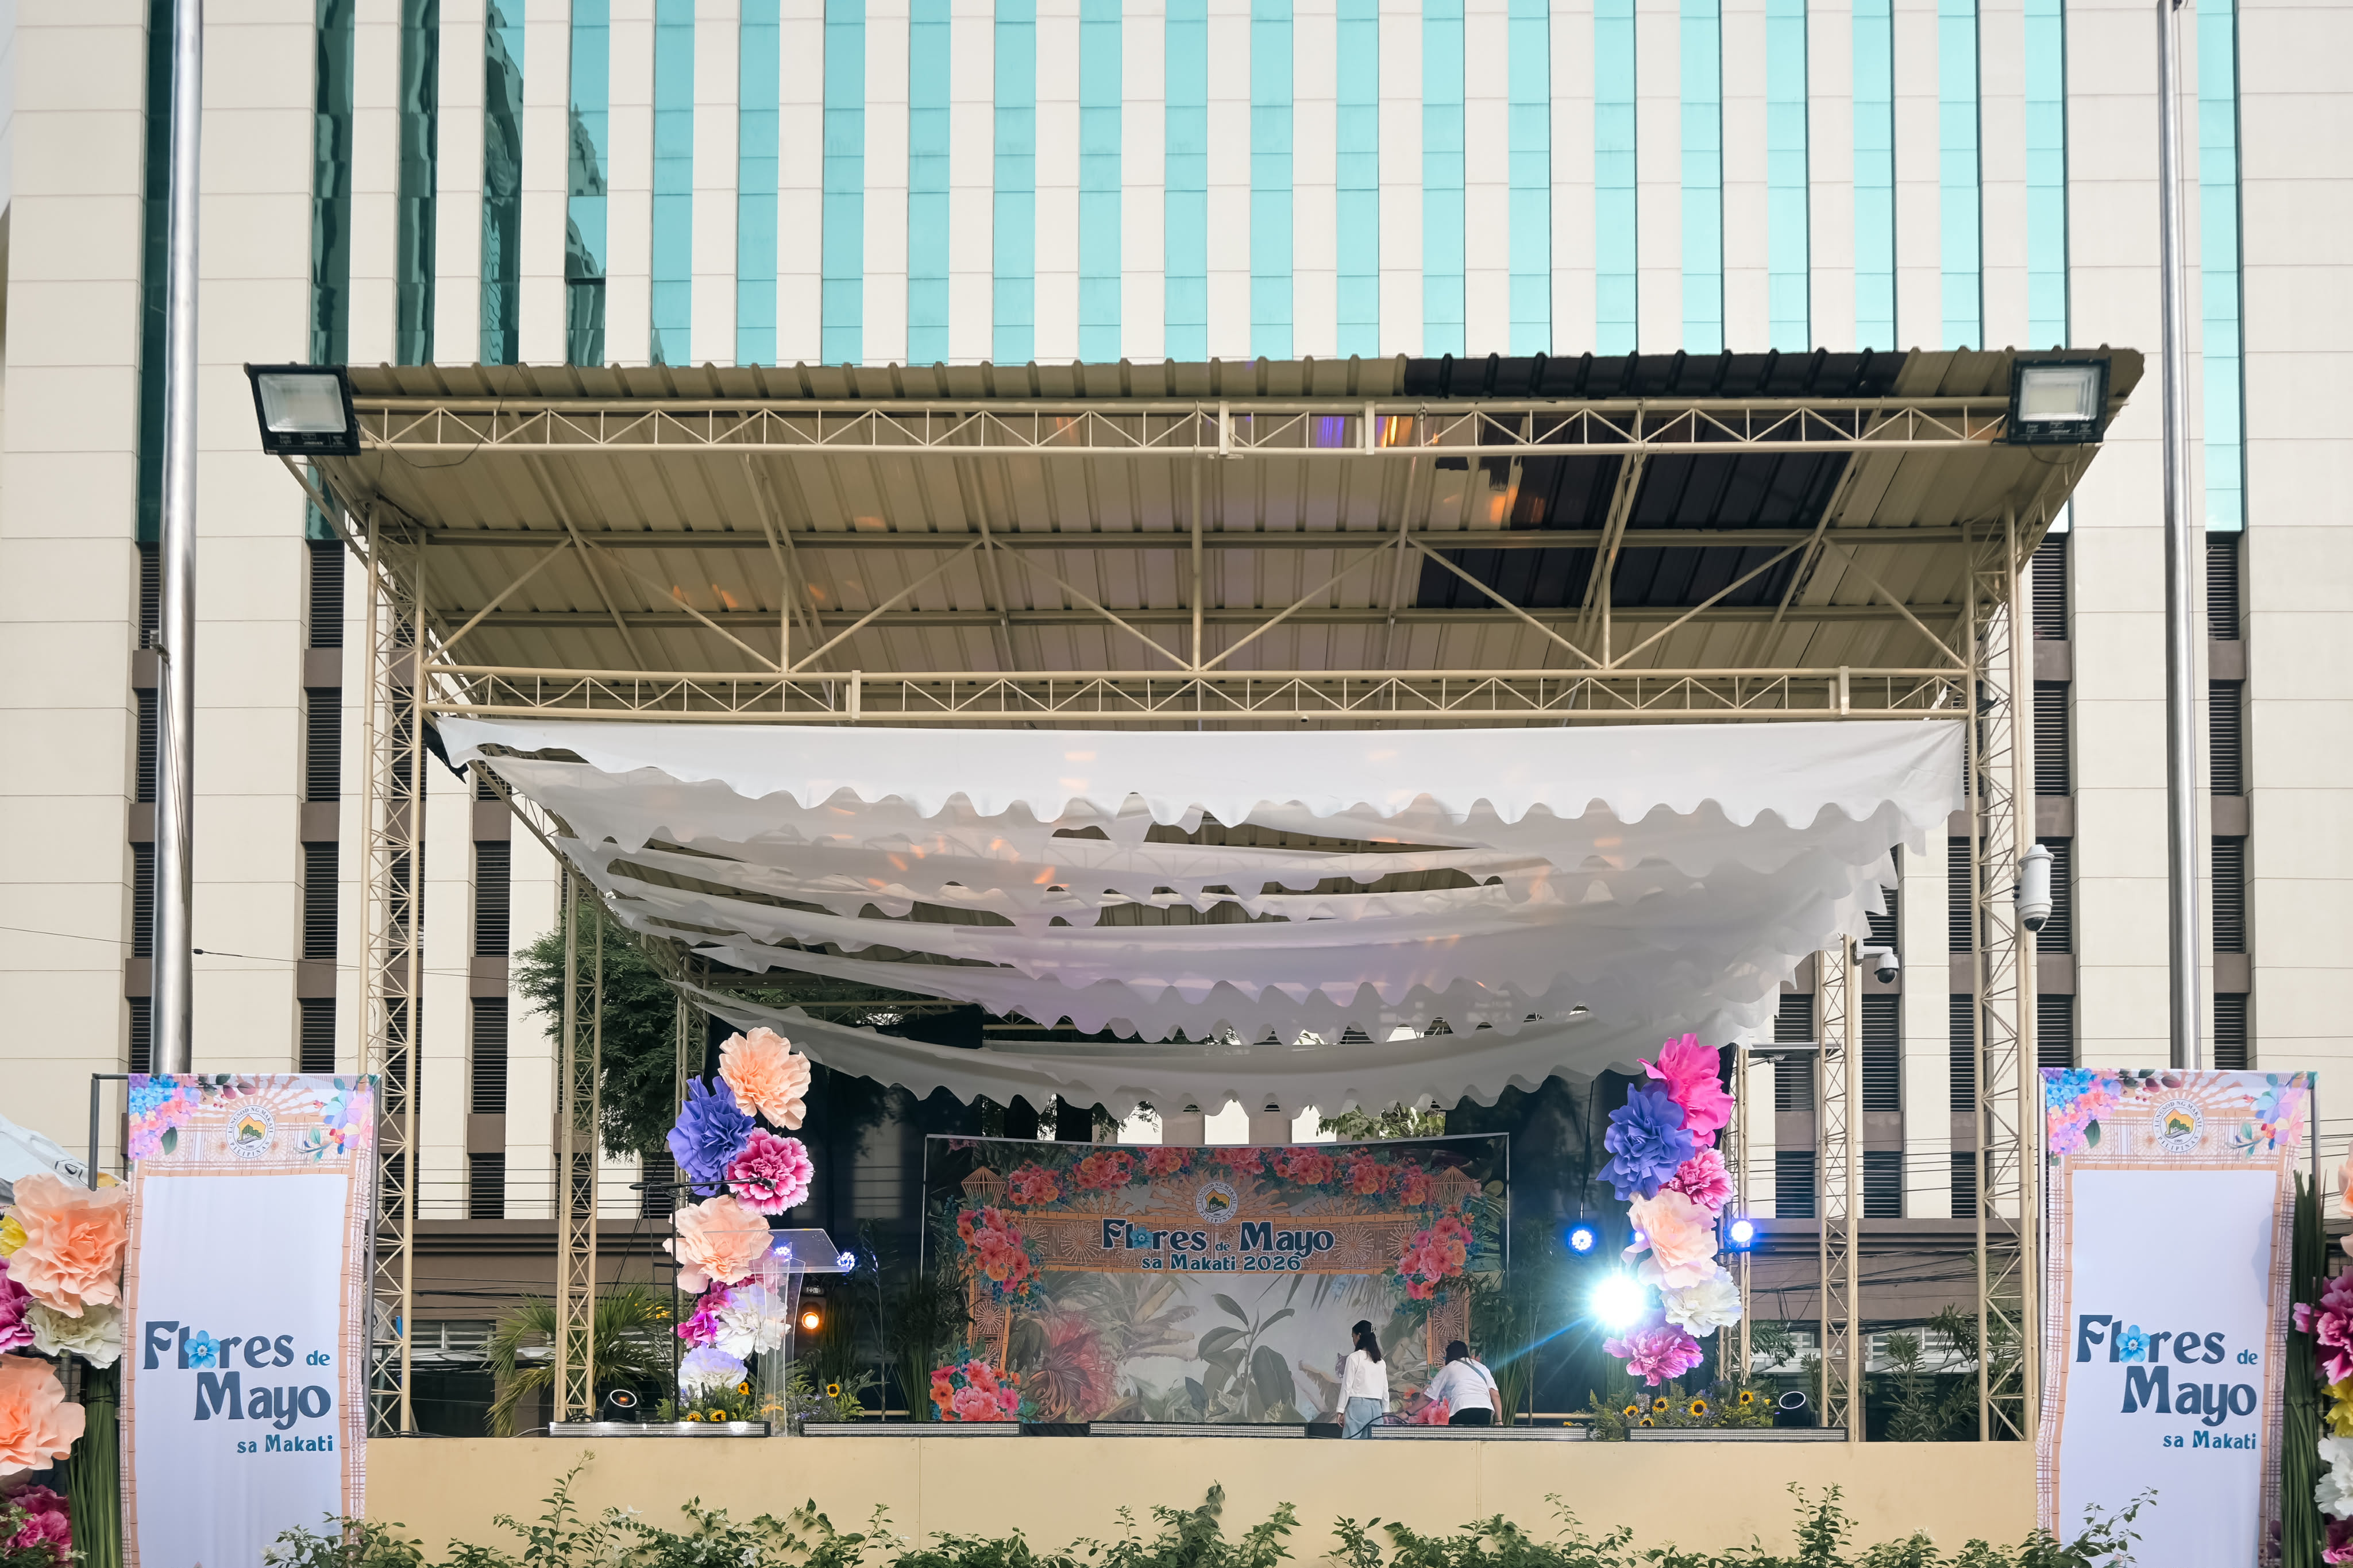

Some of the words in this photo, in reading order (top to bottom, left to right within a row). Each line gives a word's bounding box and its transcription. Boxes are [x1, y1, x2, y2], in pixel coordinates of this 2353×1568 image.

[228, 1107, 249, 1133] LUNGSOD
[261, 1110, 273, 1133] MAKATI
[2155, 1102, 2175, 1127] LUNGSOD
[2186, 1103, 2202, 1127] MAKATI
[230, 1142, 269, 1157] PILIPINAS
[2158, 1136, 2198, 1151] PILIPINAS
[1197, 1183, 1214, 1204] LUNGSOD
[1224, 1185, 1237, 1204] MAKATI
[1199, 1210, 1234, 1223] PILIPINAS
[1214, 1241, 1230, 1252] de
[1239, 1221, 1334, 1258] Mayo
[1141, 1256, 1163, 1270] sa
[1170, 1254, 1236, 1270] Makati
[1243, 1256, 1302, 1271] 2026
[306, 1349, 330, 1366] de
[2236, 1349, 2258, 1365] de
[194, 1371, 331, 1430] Mayo
[2120, 1365, 2257, 1426] Mayo
[237, 1440, 257, 1454] sa
[265, 1434, 333, 1453] Makati
[2162, 1434, 2184, 1448] sa
[2192, 1430, 2256, 1449] Makati
